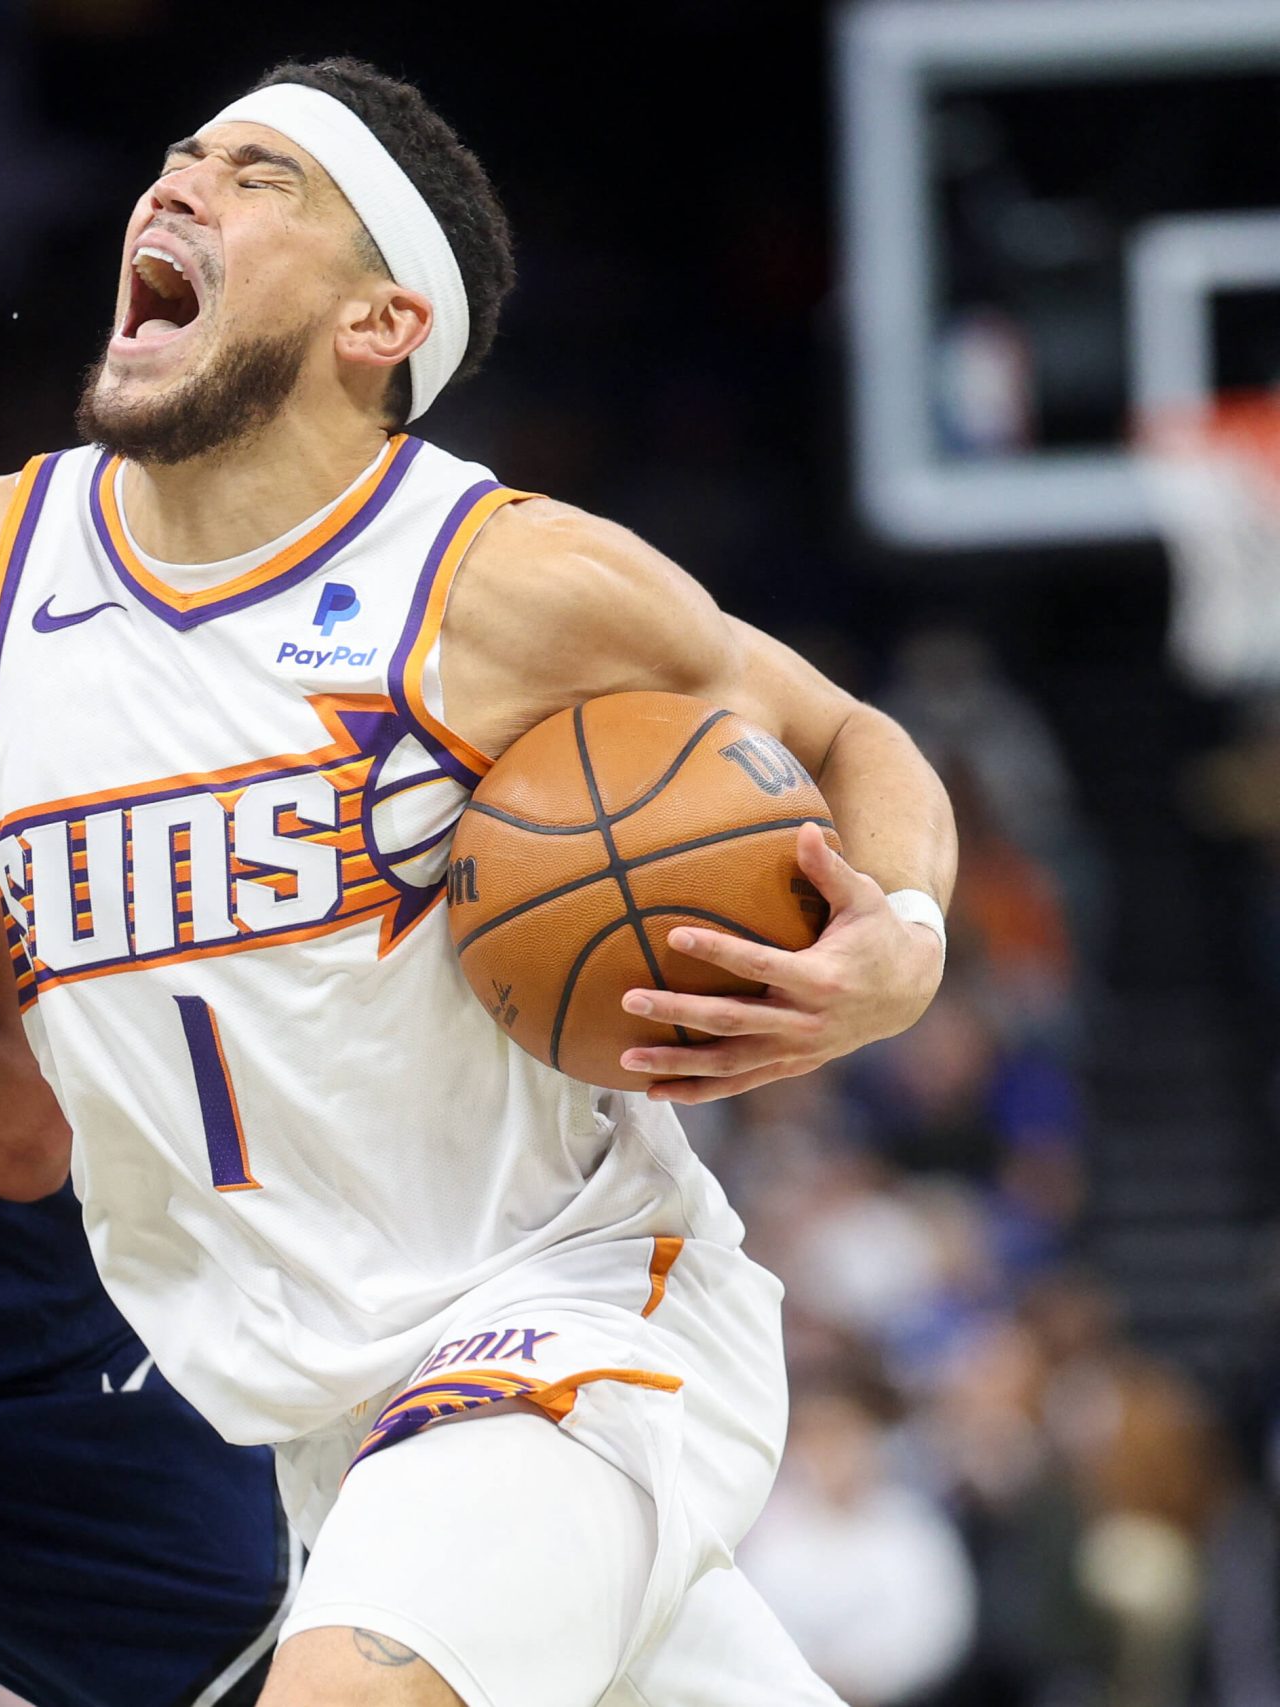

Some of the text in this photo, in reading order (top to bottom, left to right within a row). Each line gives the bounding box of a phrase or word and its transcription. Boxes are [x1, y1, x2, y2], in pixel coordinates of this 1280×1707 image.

[276, 642, 378, 668] PayPal
[172, 995, 264, 1192] 1
[413, 1328, 559, 1383] ENIX
